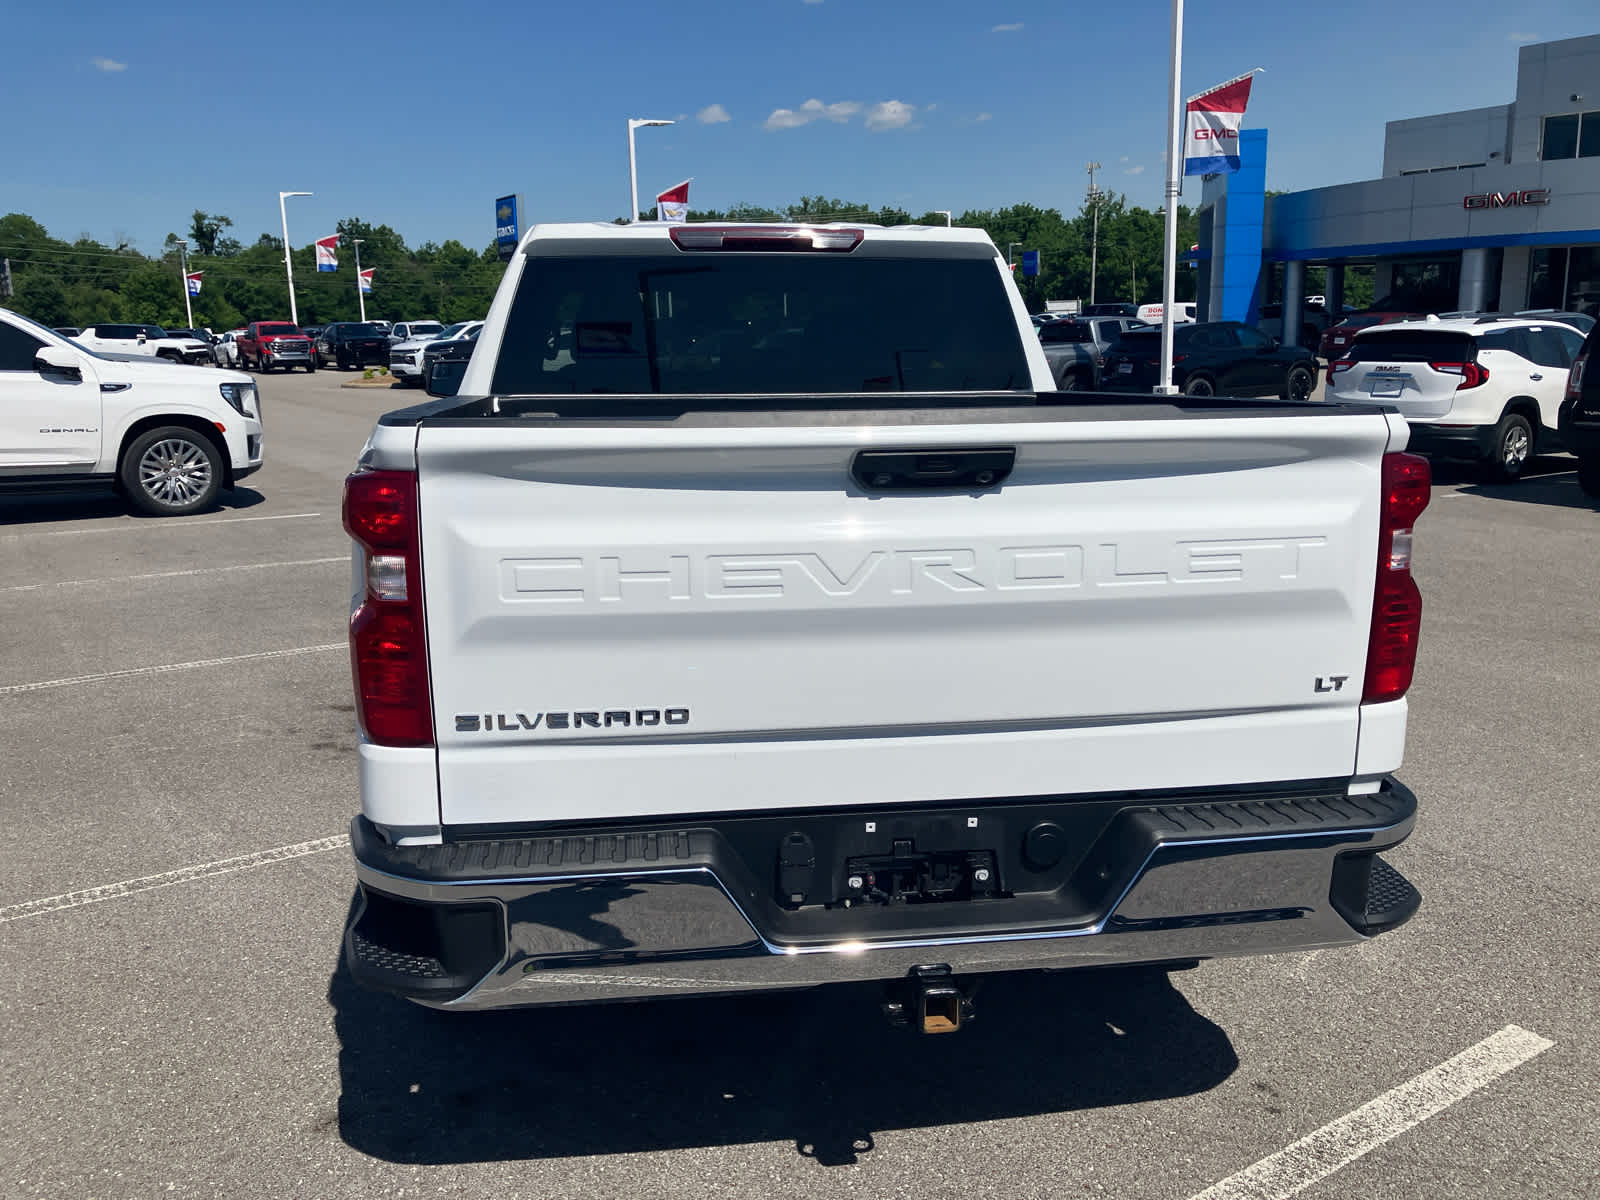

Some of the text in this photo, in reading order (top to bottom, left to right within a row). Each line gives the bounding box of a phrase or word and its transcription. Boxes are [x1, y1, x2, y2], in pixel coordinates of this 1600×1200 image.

[1194, 128, 1238, 140] GMC
[1463, 188, 1551, 209] GMC
[499, 536, 1328, 602] CHEVROLET
[1314, 676, 1349, 693] LT
[455, 708, 690, 732] SILVERADO
